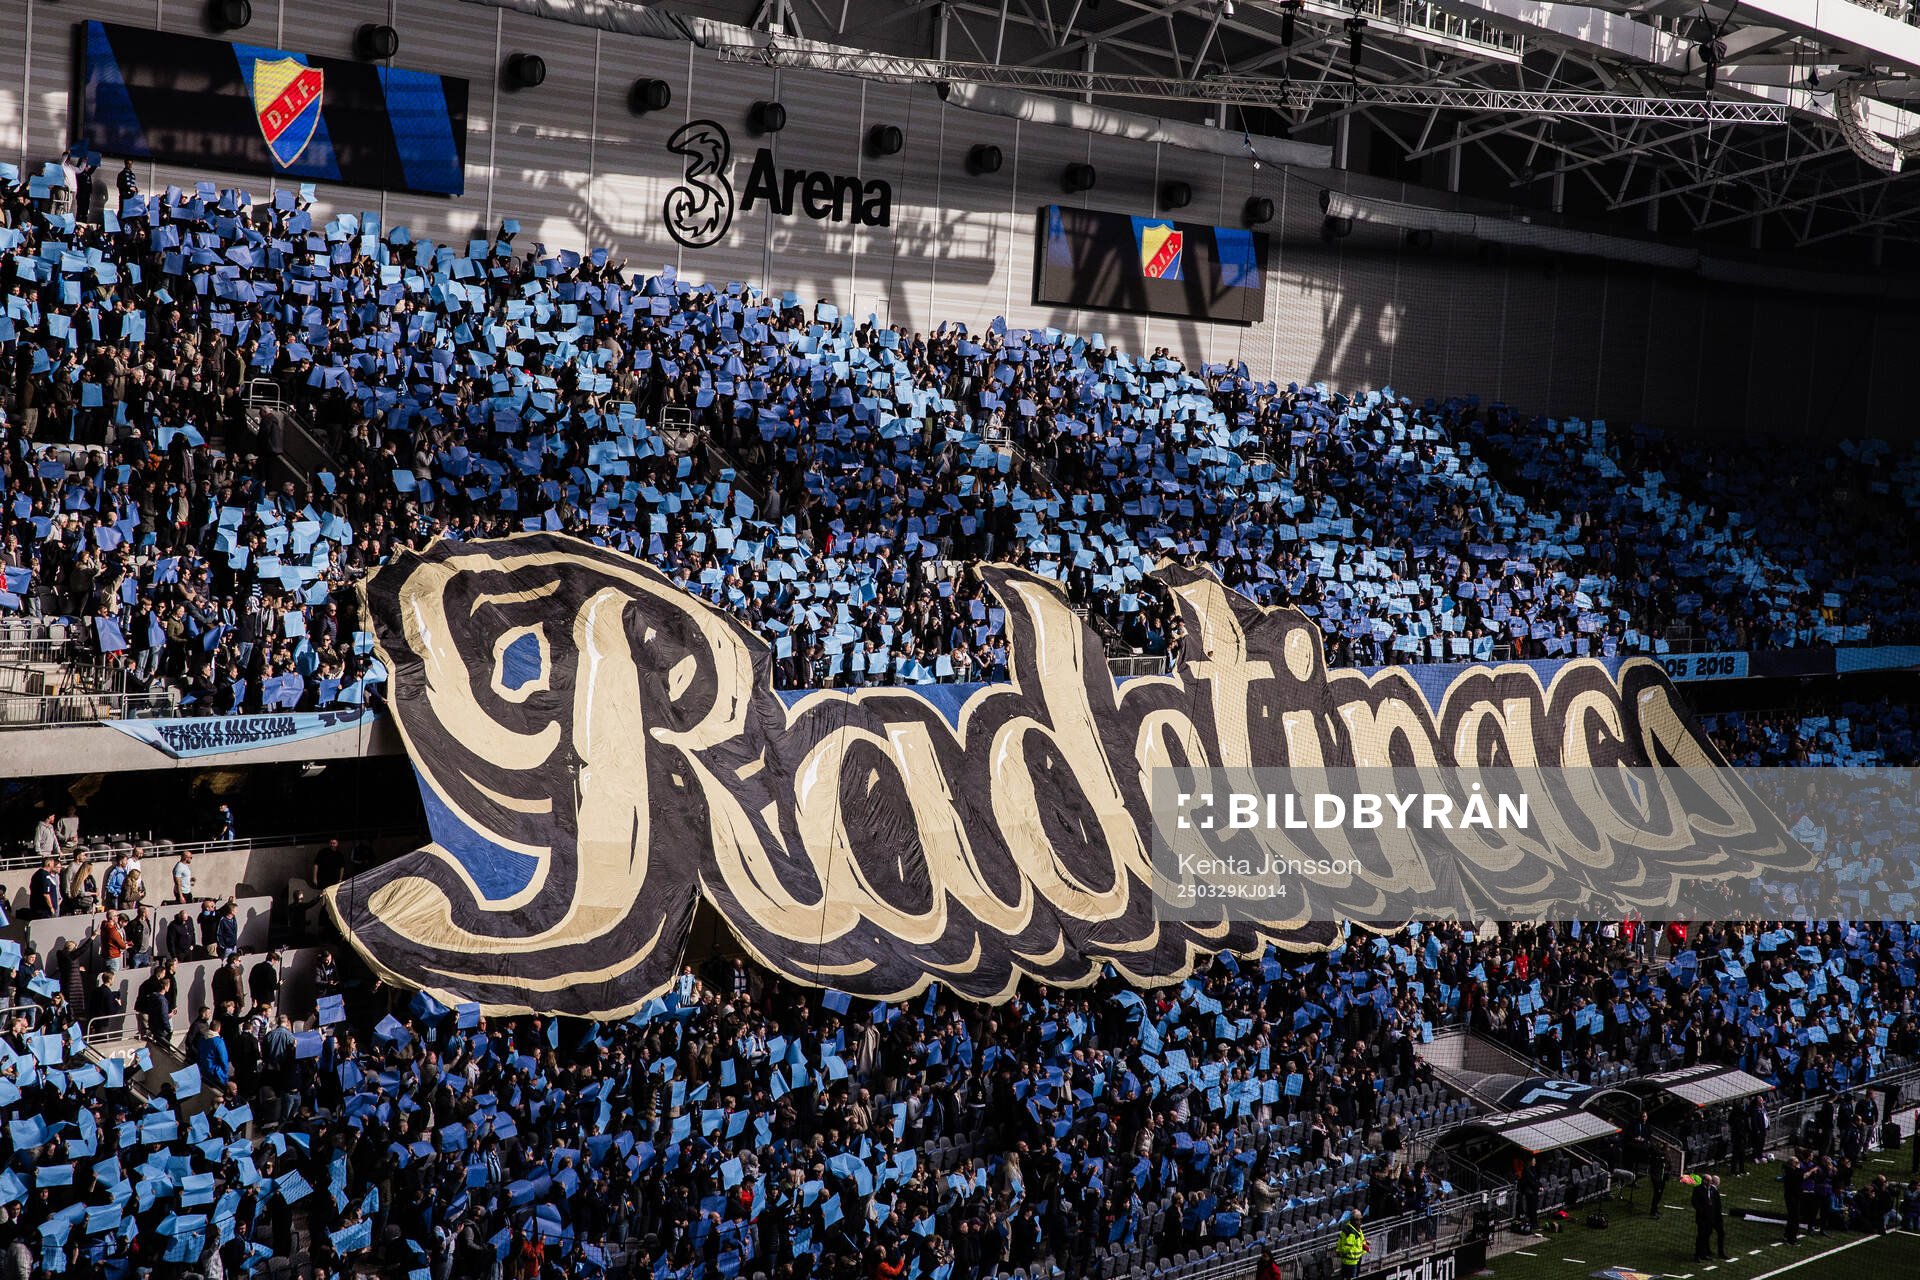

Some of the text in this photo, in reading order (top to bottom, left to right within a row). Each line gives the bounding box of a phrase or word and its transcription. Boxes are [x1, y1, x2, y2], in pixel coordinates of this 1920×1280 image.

[266, 79, 316, 130] D.I.F.
[739, 148, 891, 228] Arena
[1695, 656, 1736, 676] 2018
